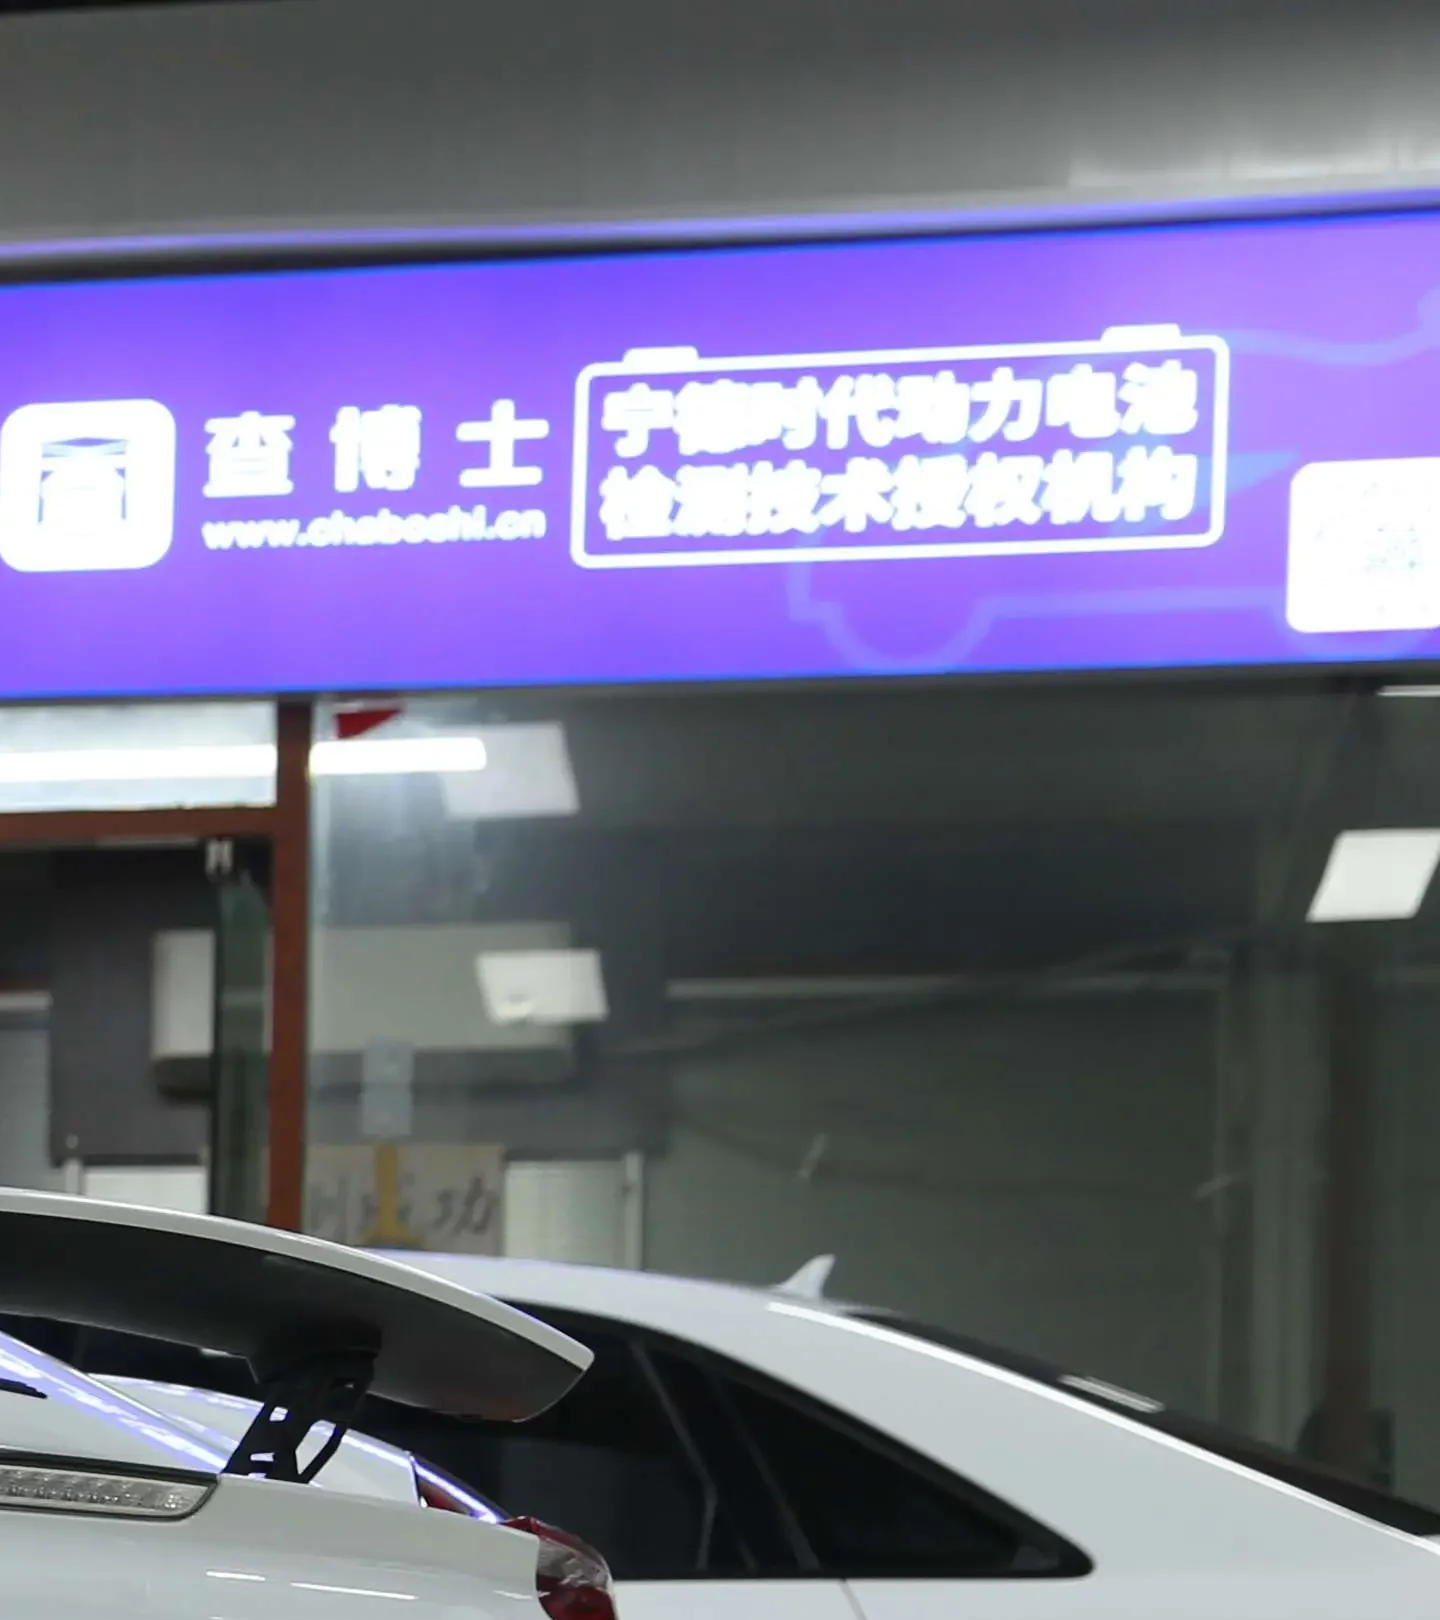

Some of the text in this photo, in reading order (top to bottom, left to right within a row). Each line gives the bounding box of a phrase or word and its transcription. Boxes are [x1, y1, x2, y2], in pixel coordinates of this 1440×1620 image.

[202, 399, 550, 498] 查博士
[201, 503, 547, 550] www.chaboshi.cn
